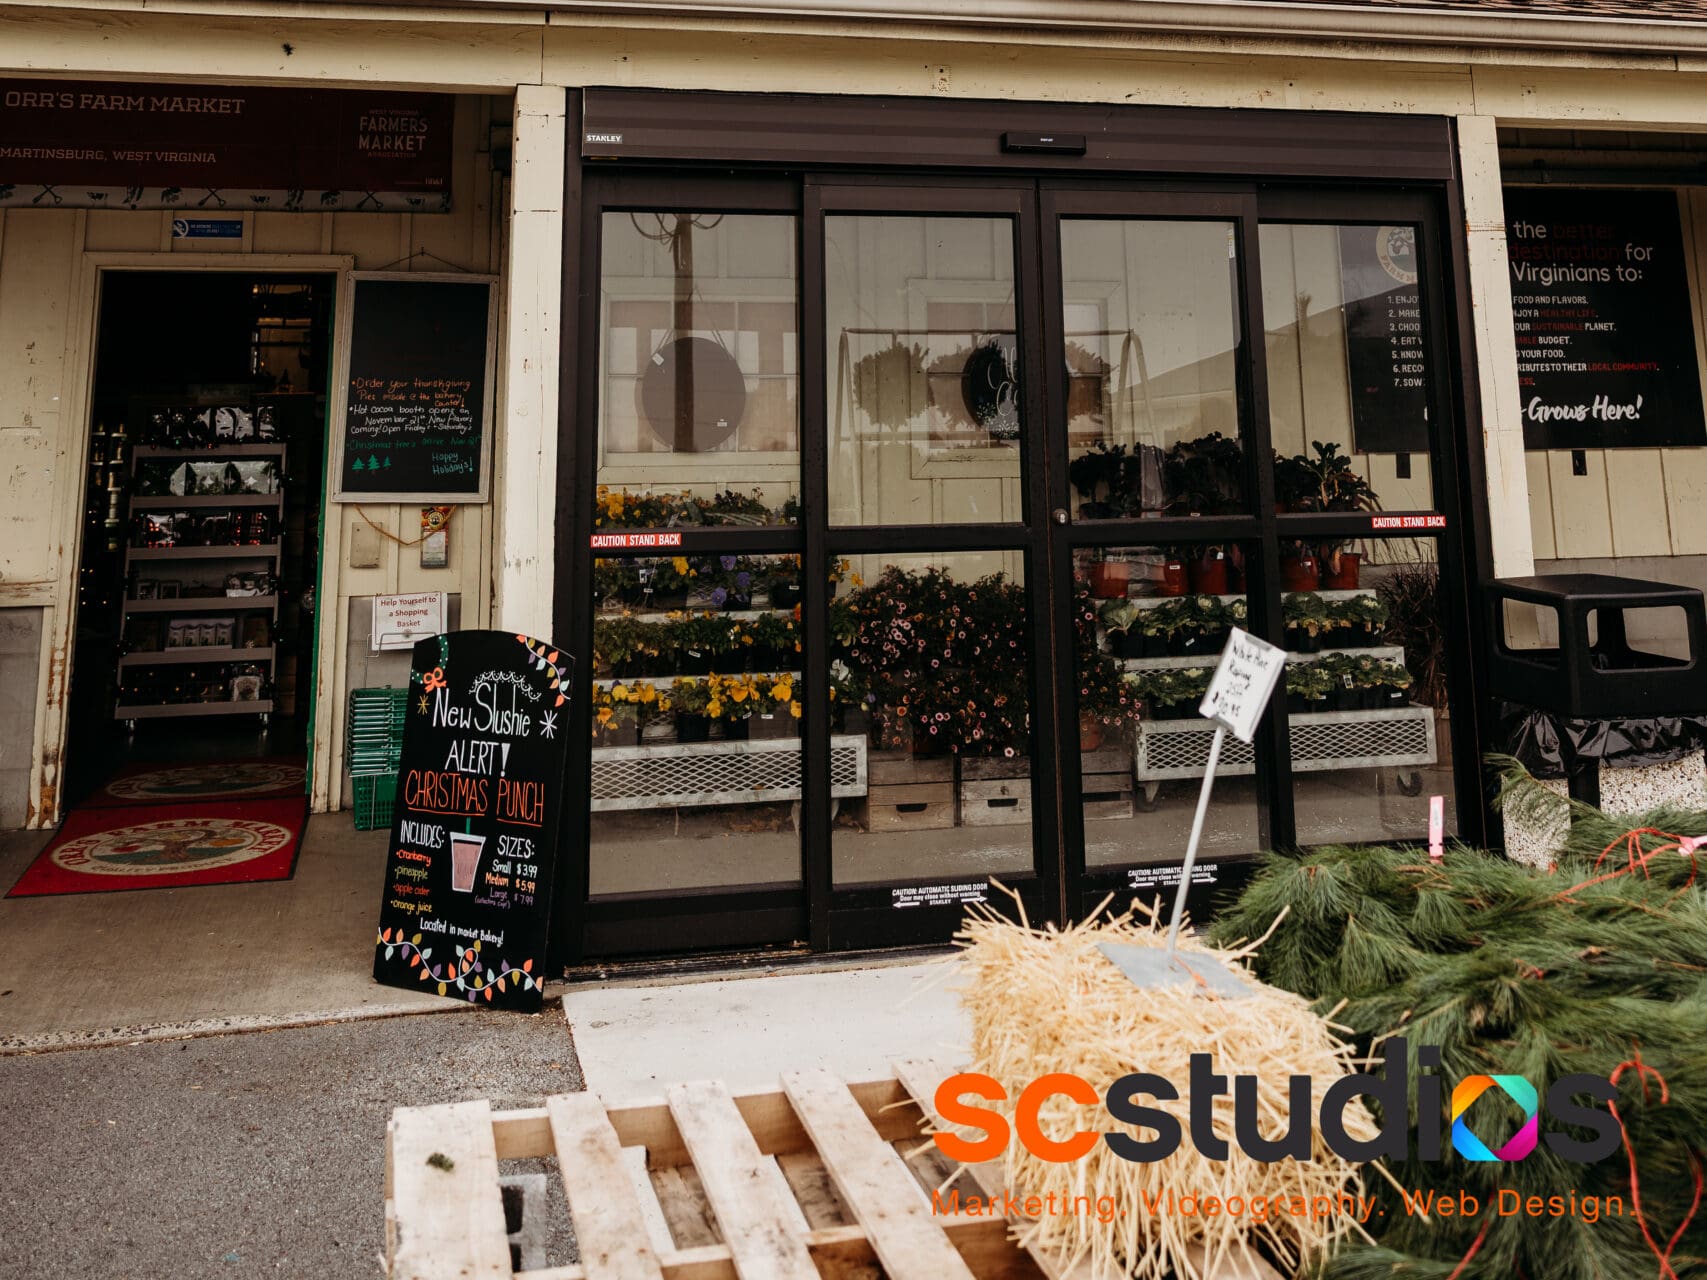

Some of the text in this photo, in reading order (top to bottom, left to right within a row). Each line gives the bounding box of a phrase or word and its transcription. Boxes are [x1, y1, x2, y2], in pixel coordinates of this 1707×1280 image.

[5, 91, 245, 114] ORR'S FARM MARKET
[360, 117, 428, 133] FARMERS
[359, 135, 426, 151] MARKET
[113, 151, 152, 162] WEST
[155, 152, 217, 163] VIRGINIA
[1513, 221, 1547, 239] the
[1625, 243, 1653, 261] for
[1511, 261, 1643, 286] Virginians to:
[1513, 296, 1589, 305] FOOD AND FLAVORS.
[1399, 309, 1420, 318] MAKE
[1584, 322, 1617, 331] PLANET.
[1538, 335, 1573, 345] BUDGET.
[1521, 349, 1542, 358] YOUR
[1543, 349, 1566, 358] FOOD.
[1402, 364, 1424, 373] RECO
[1517, 363, 1550, 372] RIBUTES
[1551, 363, 1561, 372] TO
[1562, 363, 1587, 372] THEIR
[356, 377, 384, 389] Order
[354, 405, 368, 415] Hot
[399, 405, 425, 414] booth
[428, 407, 455, 417] opens
[1528, 394, 1643, 423] Grows Here!
[365, 416, 407, 426] November
[432, 451, 459, 464] Happy
[1373, 516, 1445, 528] CAUTION STAND BACK
[592, 534, 680, 547] CAUTION STAND BACK
[380, 599, 397, 607] Help
[399, 597, 428, 605] Yourself
[395, 608, 428, 617] Shopping
[396, 620, 421, 628] Basket
[432, 682, 531, 737] New Slushie
[444, 739, 511, 778] ALERT!
[405, 770, 545, 822] CHRISTMAS PUNCH
[400, 819, 445, 849] INCLUDES:
[497, 835, 535, 859] SIZES:
[398, 849, 432, 867] cranberry
[396, 865, 429, 882] pineapple
[492, 859, 512, 874] Small
[1152, 867, 1182, 875] AUTOMATIC
[485, 872, 509, 888] Medium
[394, 883, 430, 897] apple cider
[490, 887, 508, 903] Large
[892, 883, 988, 897] CAUTION: AUTOMATIC SLIDING DOOR
[392, 900, 433, 915] orange juice
[420, 917, 504, 948] Located in market Bakery!
